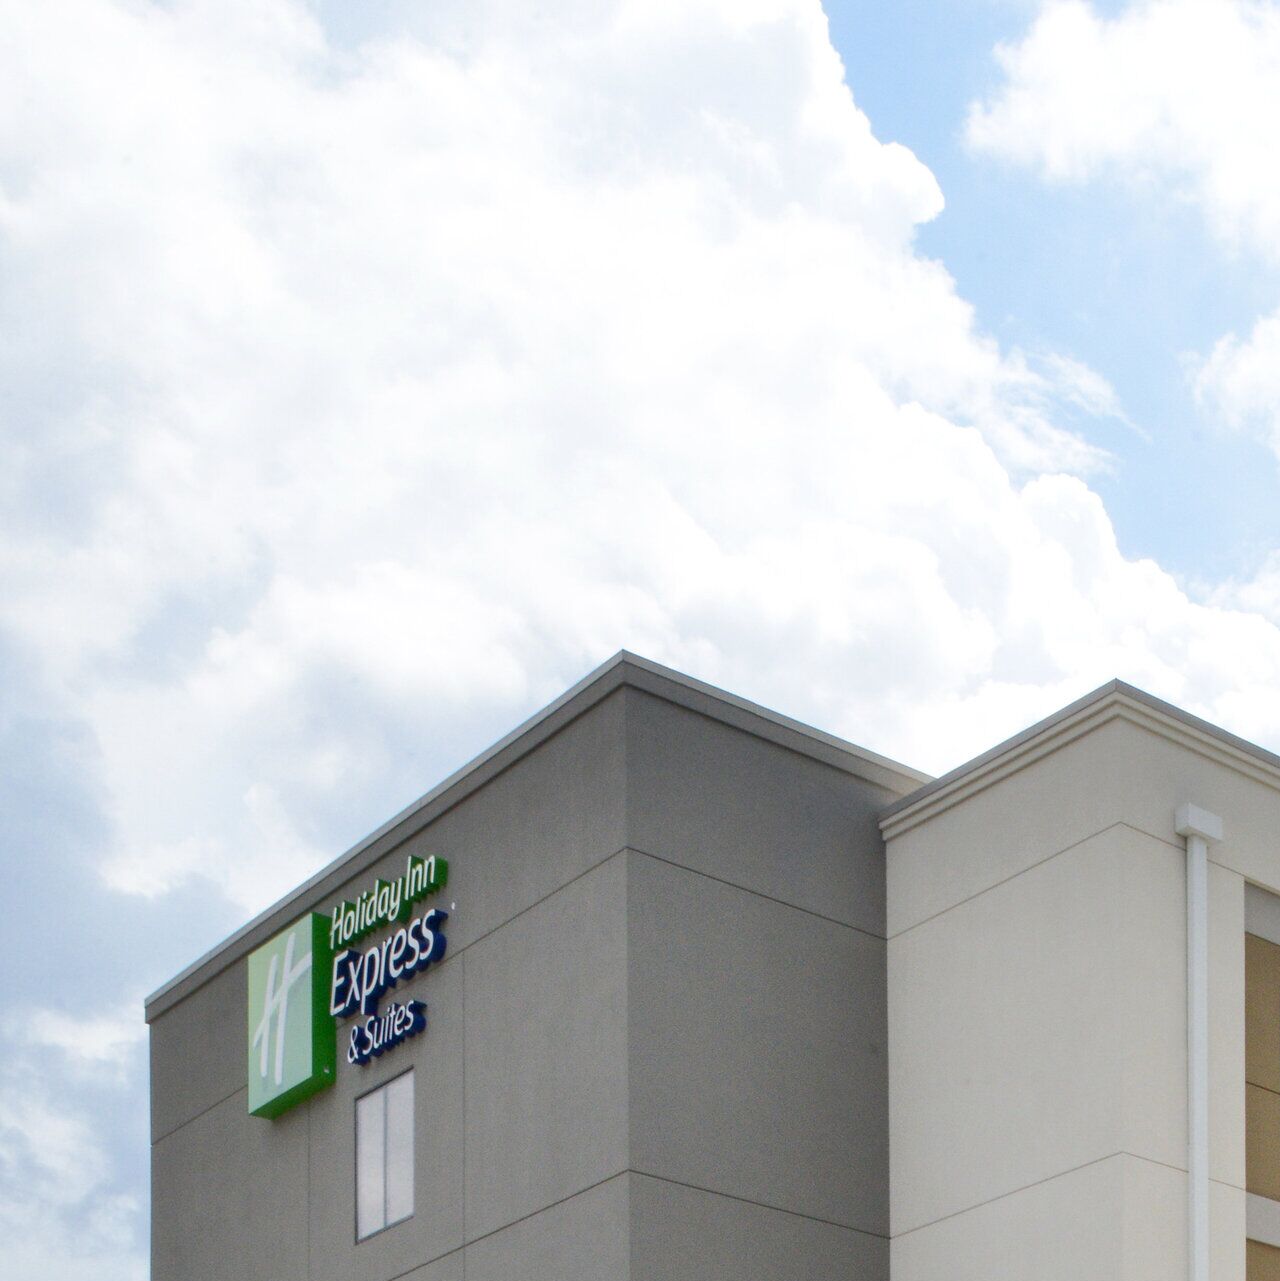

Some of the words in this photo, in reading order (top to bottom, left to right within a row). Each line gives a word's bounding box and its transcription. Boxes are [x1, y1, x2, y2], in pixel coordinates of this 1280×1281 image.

[329, 877, 403, 949] Holiday
[404, 855, 437, 901] Inn
[330, 908, 436, 1016] Express
[347, 1025, 360, 1064] &
[362, 1000, 415, 1056] Suites
